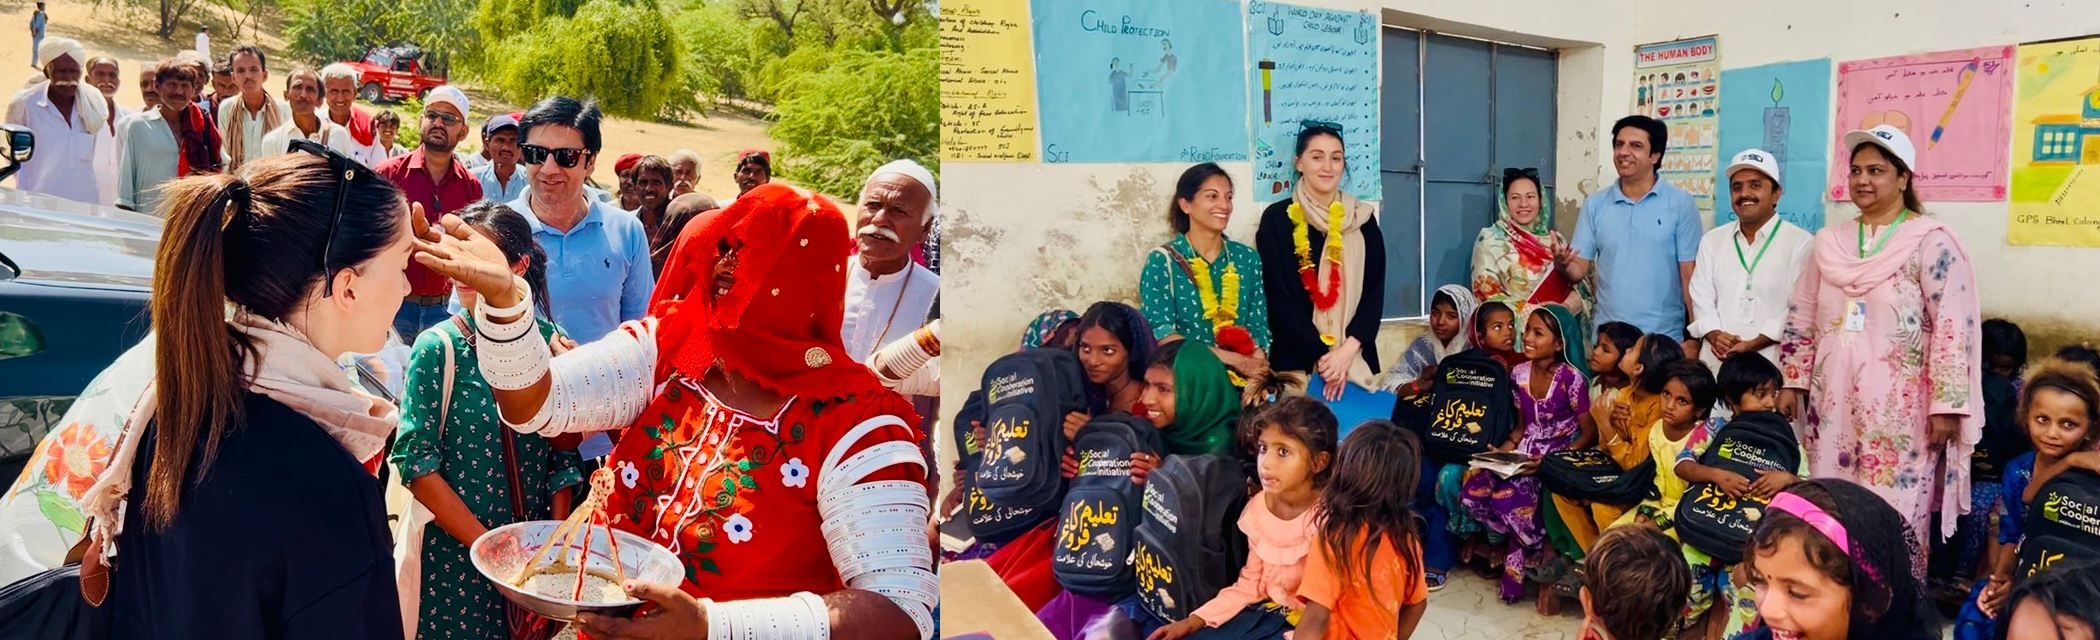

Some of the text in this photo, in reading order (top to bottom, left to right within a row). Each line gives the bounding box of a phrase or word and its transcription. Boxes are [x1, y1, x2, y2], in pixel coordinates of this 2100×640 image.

[1081, 10, 1169, 37] CHILD PROTECTION
[1640, 44, 1713, 62] THE HUMAN BODY
[1047, 143, 1069, 163] SCI
[2016, 214, 2039, 224] GPS
[1456, 373, 1495, 382] Cooperation
[997, 378, 1034, 394] Cooperation
[1089, 448, 1110, 459] Social
[1736, 441, 1766, 456] Social
[1088, 457, 1130, 467] Cooperation
[2061, 495, 2098, 516] Social
[1080, 500, 1119, 533] تعلیم
[1057, 518, 1090, 551] فروغ
[1077, 552, 1087, 567] کی
